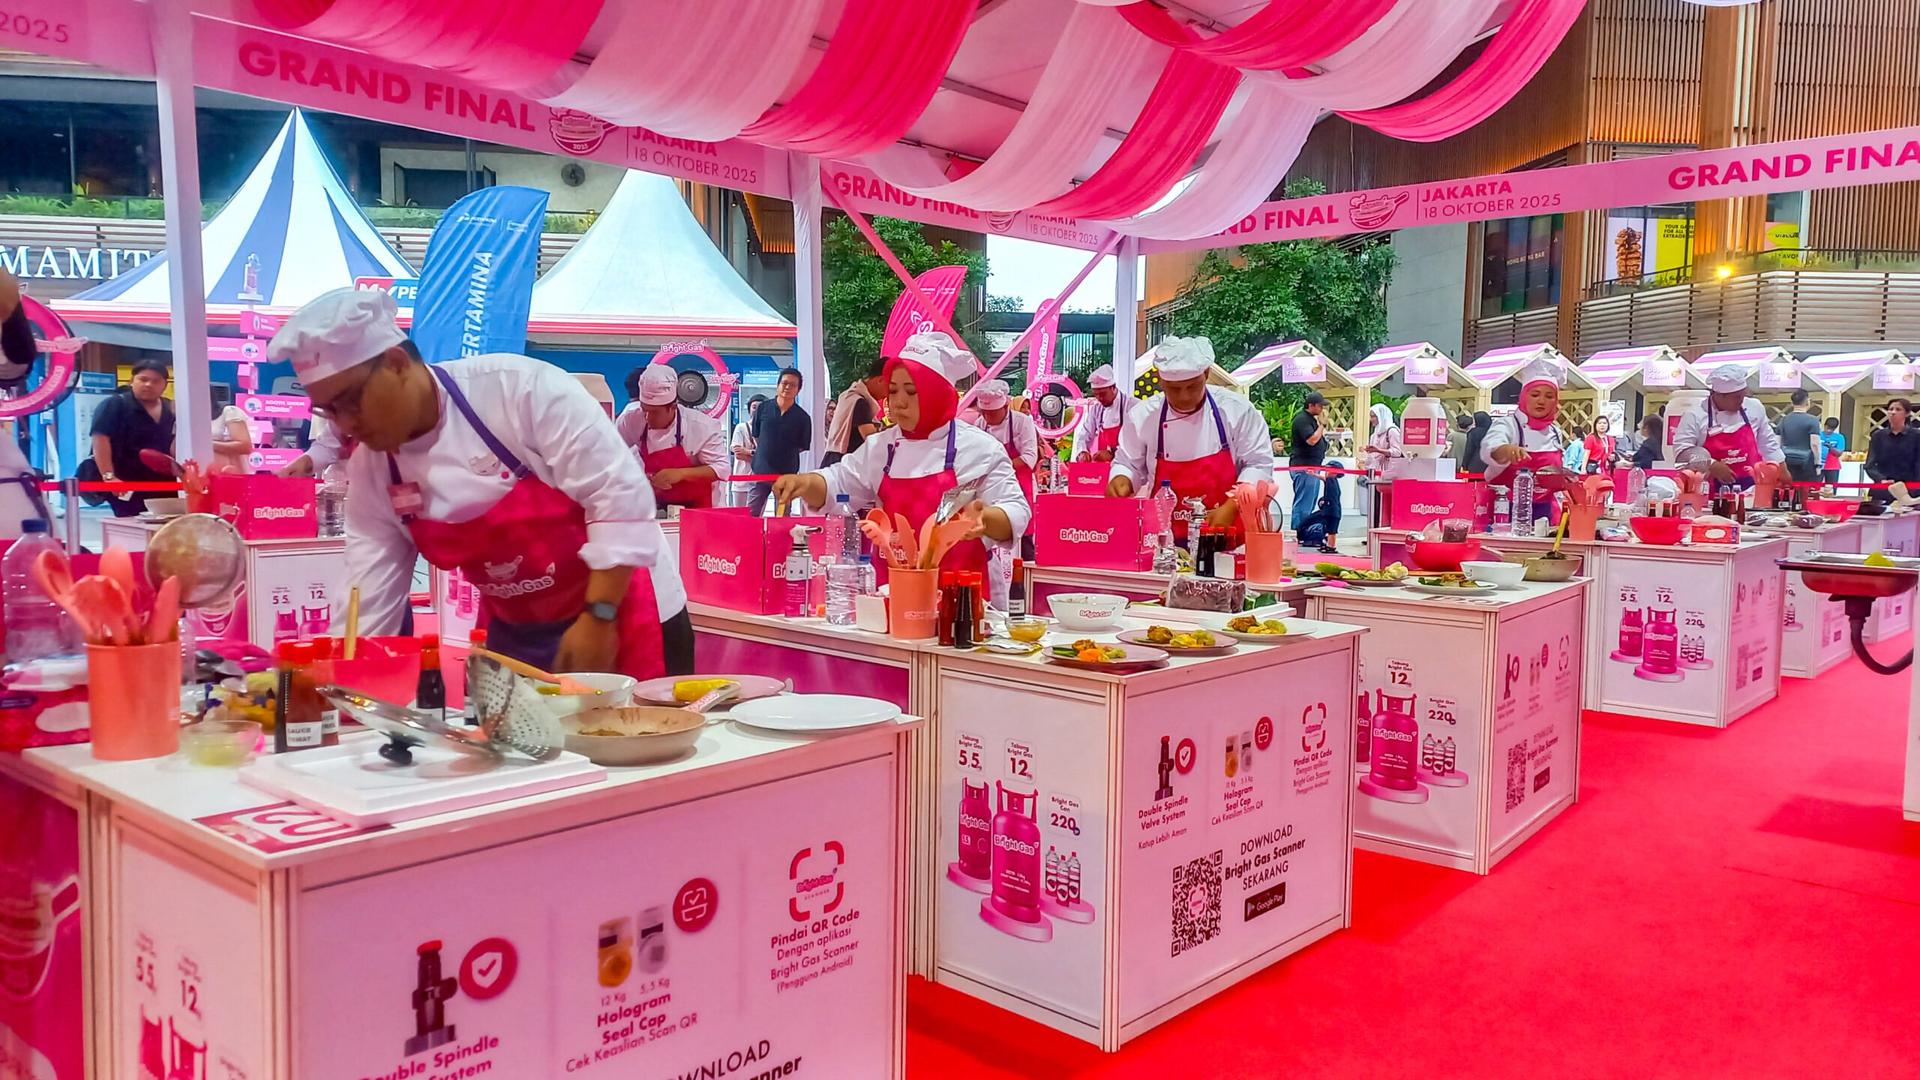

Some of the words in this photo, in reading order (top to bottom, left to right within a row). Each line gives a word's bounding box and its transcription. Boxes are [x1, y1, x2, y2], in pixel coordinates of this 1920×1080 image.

[0, 11, 69, 43] 2025
[238, 41, 411, 104] GRAND
[424, 82, 536, 132] FINAL
[634, 147, 647, 162] 18
[653, 151, 719, 177] OKTOBER
[723, 165, 757, 184] 2025
[1668, 153, 1812, 190] GRAND
[1825, 140, 1920, 173] FINA
[833, 172, 917, 207] GRAND
[1422, 180, 1512, 202] JAKARTA
[1264, 205, 1339, 231] FINAL
[1424, 207, 1437, 219] 18
[1442, 199, 1514, 217] OKTOBER
[1520, 193, 1561, 209] 2025
[1040, 225, 1077, 245] OKTOBER
[1078, 231, 1098, 246] 2025
[254, 507, 284, 519] Bright
[285, 509, 304, 517] Gas
[1411, 503, 1434, 515] Bright
[1434, 505, 1449, 514] Gas
[1060, 528, 1089, 542] Bright
[1090, 530, 1108, 543] Gas
[698, 554, 721, 575] Bright
[720, 558, 737, 575] Gas
[520, 576, 554, 592] Gas
[1224, 786, 1253, 800] Hologram
[1225, 801, 1238, 812] Seal
[1240, 798, 1251, 808] Cap
[1139, 804, 1162, 819] Double
[1164, 796, 1188, 813] Spindle
[1141, 817, 1160, 831] Valve
[1162, 810, 1186, 825] System
[994, 834, 1018, 851] Bright
[1019, 842, 1035, 856] Gas
[1241, 824, 1293, 855] DOWNLOAD
[1225, 860, 1252, 880] Bright
[1254, 852, 1271, 867] Gas
[1273, 838, 1306, 859] Scanner
[1243, 860, 1289, 890] SEKARANG
[771, 926, 807, 948] Pindai
[811, 919, 828, 934] QR
[832, 908, 860, 926] Code
[777, 940, 814, 961] Dengan
[817, 927, 851, 947] aplikasi
[771, 962, 799, 980] Bright
[802, 955, 820, 968] Gas
[823, 941, 859, 960] Scanner
[777, 971, 818, 993] (Pengguna
[821, 955, 853, 975] Android)
[658, 978, 670, 989] Kg
[597, 993, 671, 1027] Hologram
[601, 996, 611, 1006] 12
[614, 993, 626, 1004] Kg
[566, 1054, 590, 1072] Cek
[594, 1037, 645, 1062] Keaslian
[649, 1024, 676, 1042] Scan
[680, 1012, 698, 1029] QR
[602, 1021, 634, 1045] Seal
[639, 1014, 666, 1031] Cap
[433, 1035, 499, 1068] Spindle
